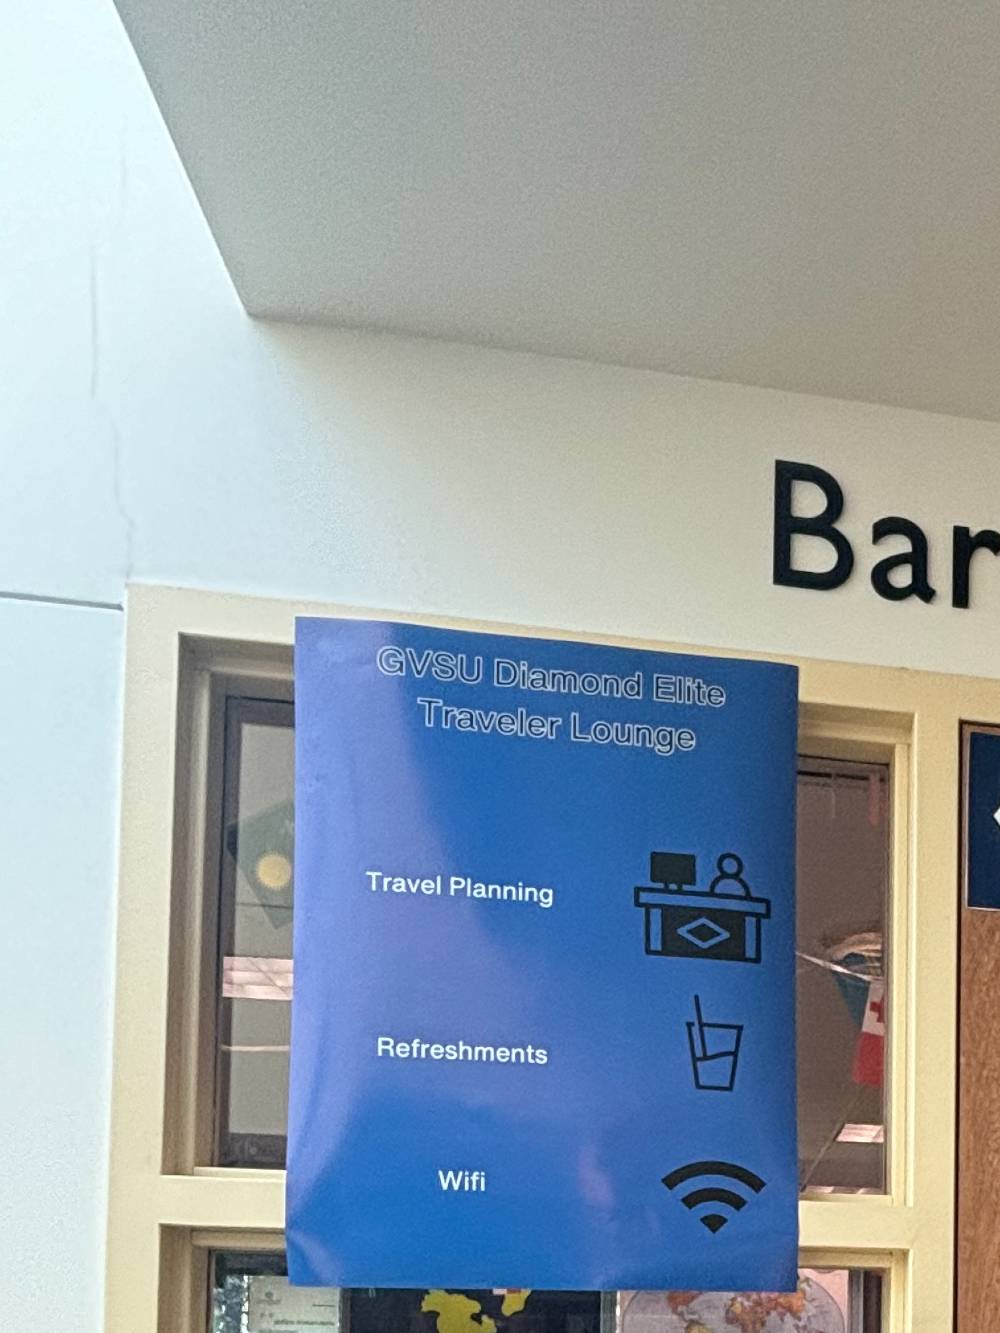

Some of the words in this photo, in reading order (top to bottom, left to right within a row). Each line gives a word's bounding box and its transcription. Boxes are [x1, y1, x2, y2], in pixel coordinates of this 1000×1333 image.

[377, 645, 483, 686] GVSU
[494, 657, 642, 699] Diamond
[653, 674, 726, 708] Elite
[417, 696, 560, 740] Traveler
[571, 707, 696, 756] Lounge
[366, 871, 442, 896] Travel
[449, 876, 554, 908] Planning
[376, 1037, 549, 1065] Refreshments
[438, 1170, 486, 1192] Wifi
